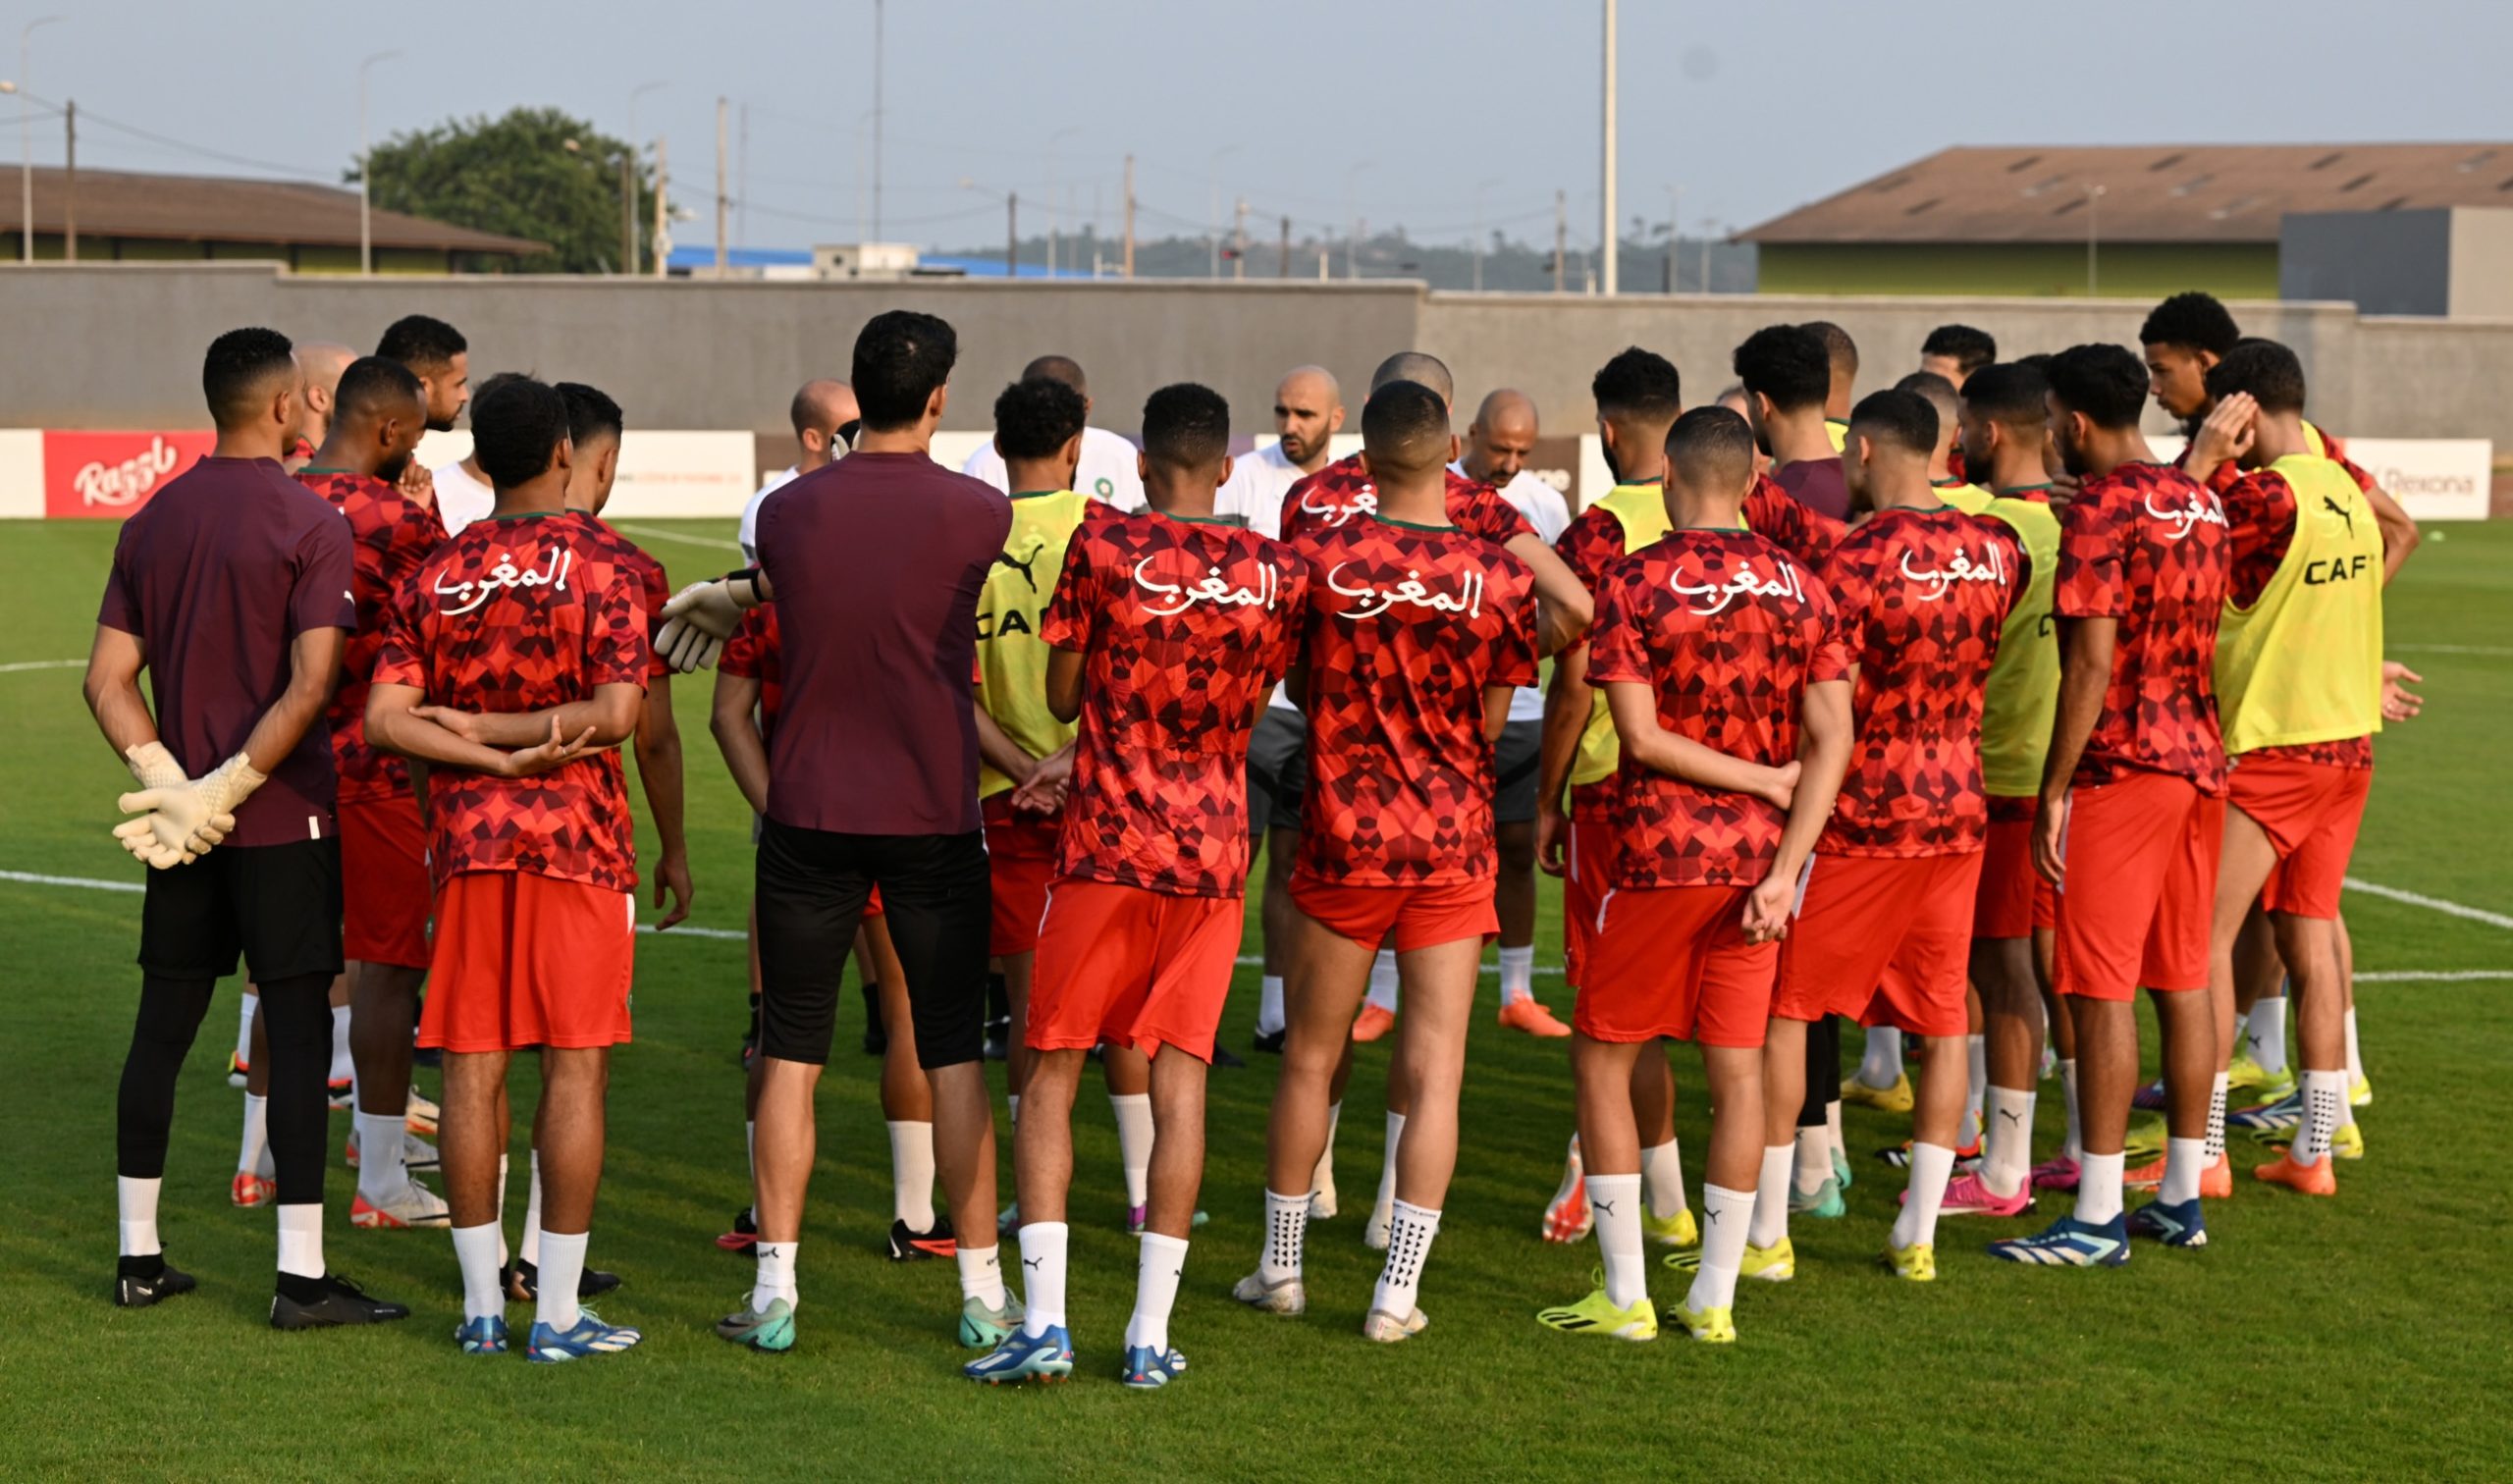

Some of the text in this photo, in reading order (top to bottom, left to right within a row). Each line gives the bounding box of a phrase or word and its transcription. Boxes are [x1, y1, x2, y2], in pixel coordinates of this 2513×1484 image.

[2384, 467, 2476, 495] Rexona
[2145, 488, 2230, 539] المغرب
[434, 546, 571, 615] المغرب
[1134, 556, 1276, 615] المغرب
[1327, 561, 1483, 619] المغرب
[1670, 560, 1805, 615] المغرب
[1900, 541, 2005, 601] المغرب
[2304, 556, 2367, 585] CAF
